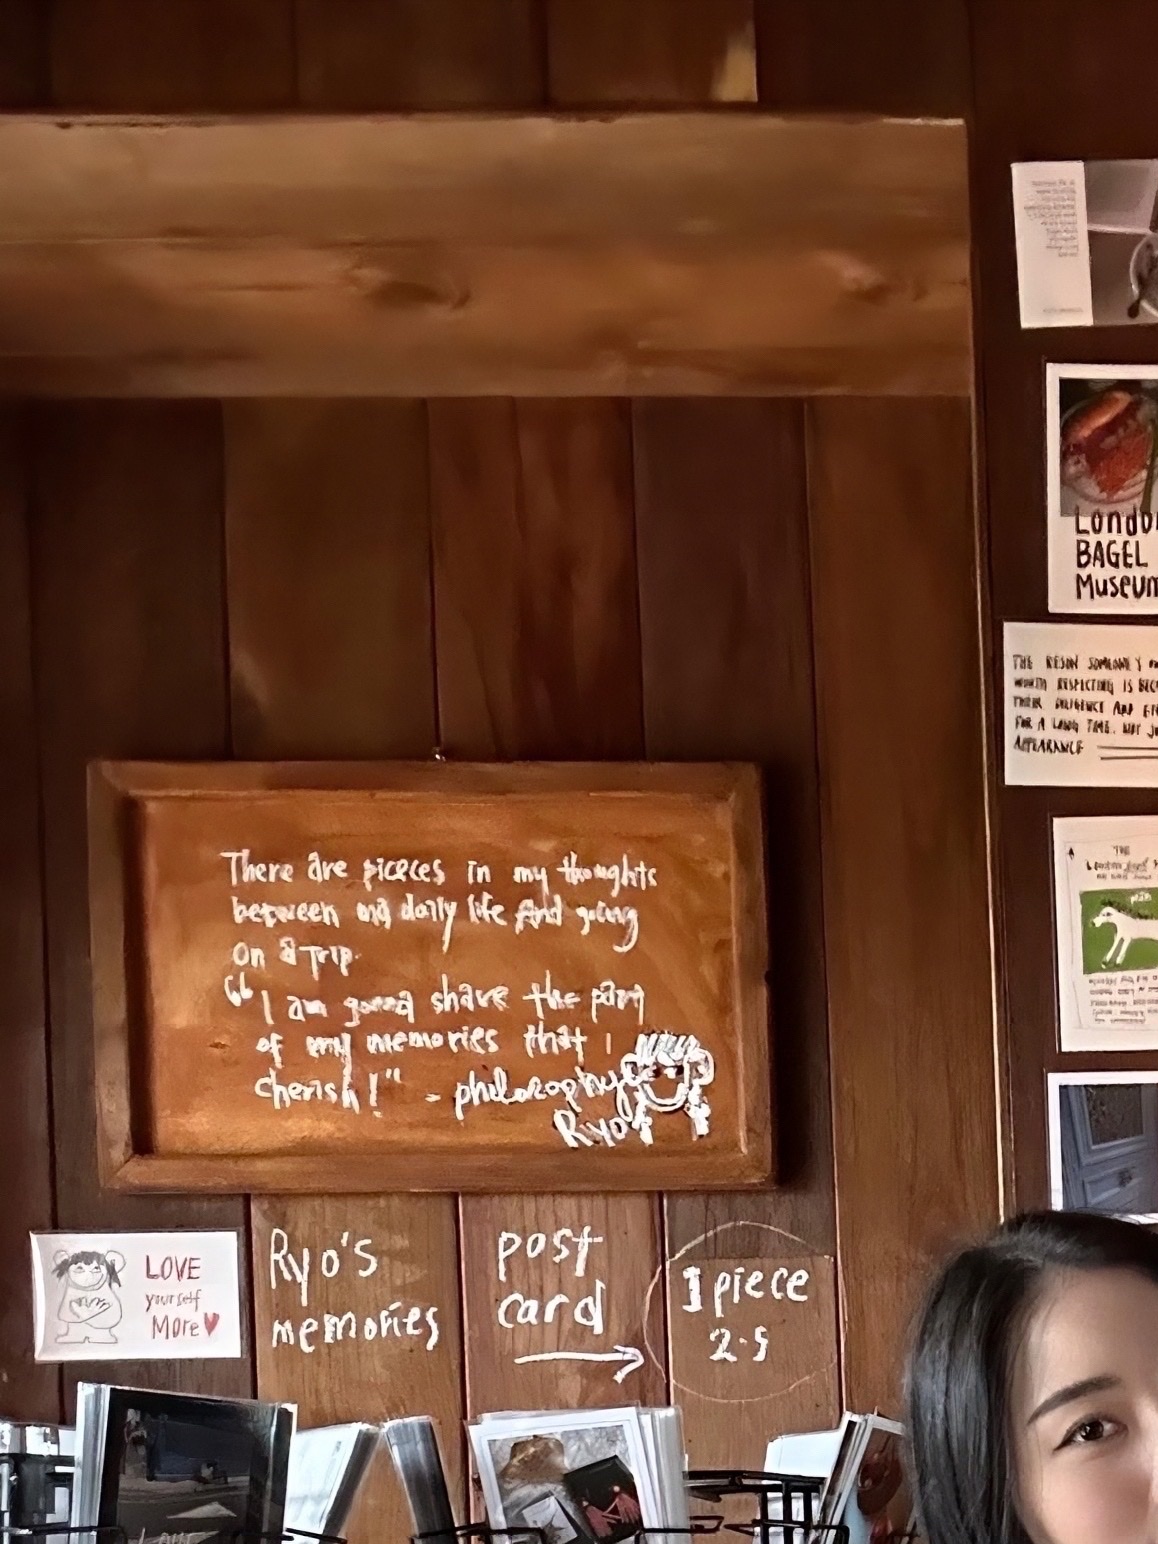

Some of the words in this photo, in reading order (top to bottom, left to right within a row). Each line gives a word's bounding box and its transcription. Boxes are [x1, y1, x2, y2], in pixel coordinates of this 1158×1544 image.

[1076, 539, 1149, 569] BAGEL
[1013, 654, 1033, 670] THE
[1123, 679, 1134, 694] IS
[219, 848, 294, 887] There
[308, 851, 349, 883] are
[467, 860, 492, 885] in
[513, 865, 550, 897] my
[231, 896, 340, 929] between
[467, 891, 508, 926] life
[286, 995, 328, 1023] am
[522, 969, 582, 1020] the
[255, 1032, 285, 1070] of
[366, 1025, 500, 1056] memories
[523, 1020, 588, 1066] that
[145, 1254, 201, 1282] LOVE
[270, 1228, 378, 1307] Ryo's
[497, 1225, 604, 1283] post
[145, 1288, 202, 1313] yourself
[497, 1279, 606, 1335] card
[713, 1266, 810, 1318] piece
[271, 1301, 440, 1353] memories
